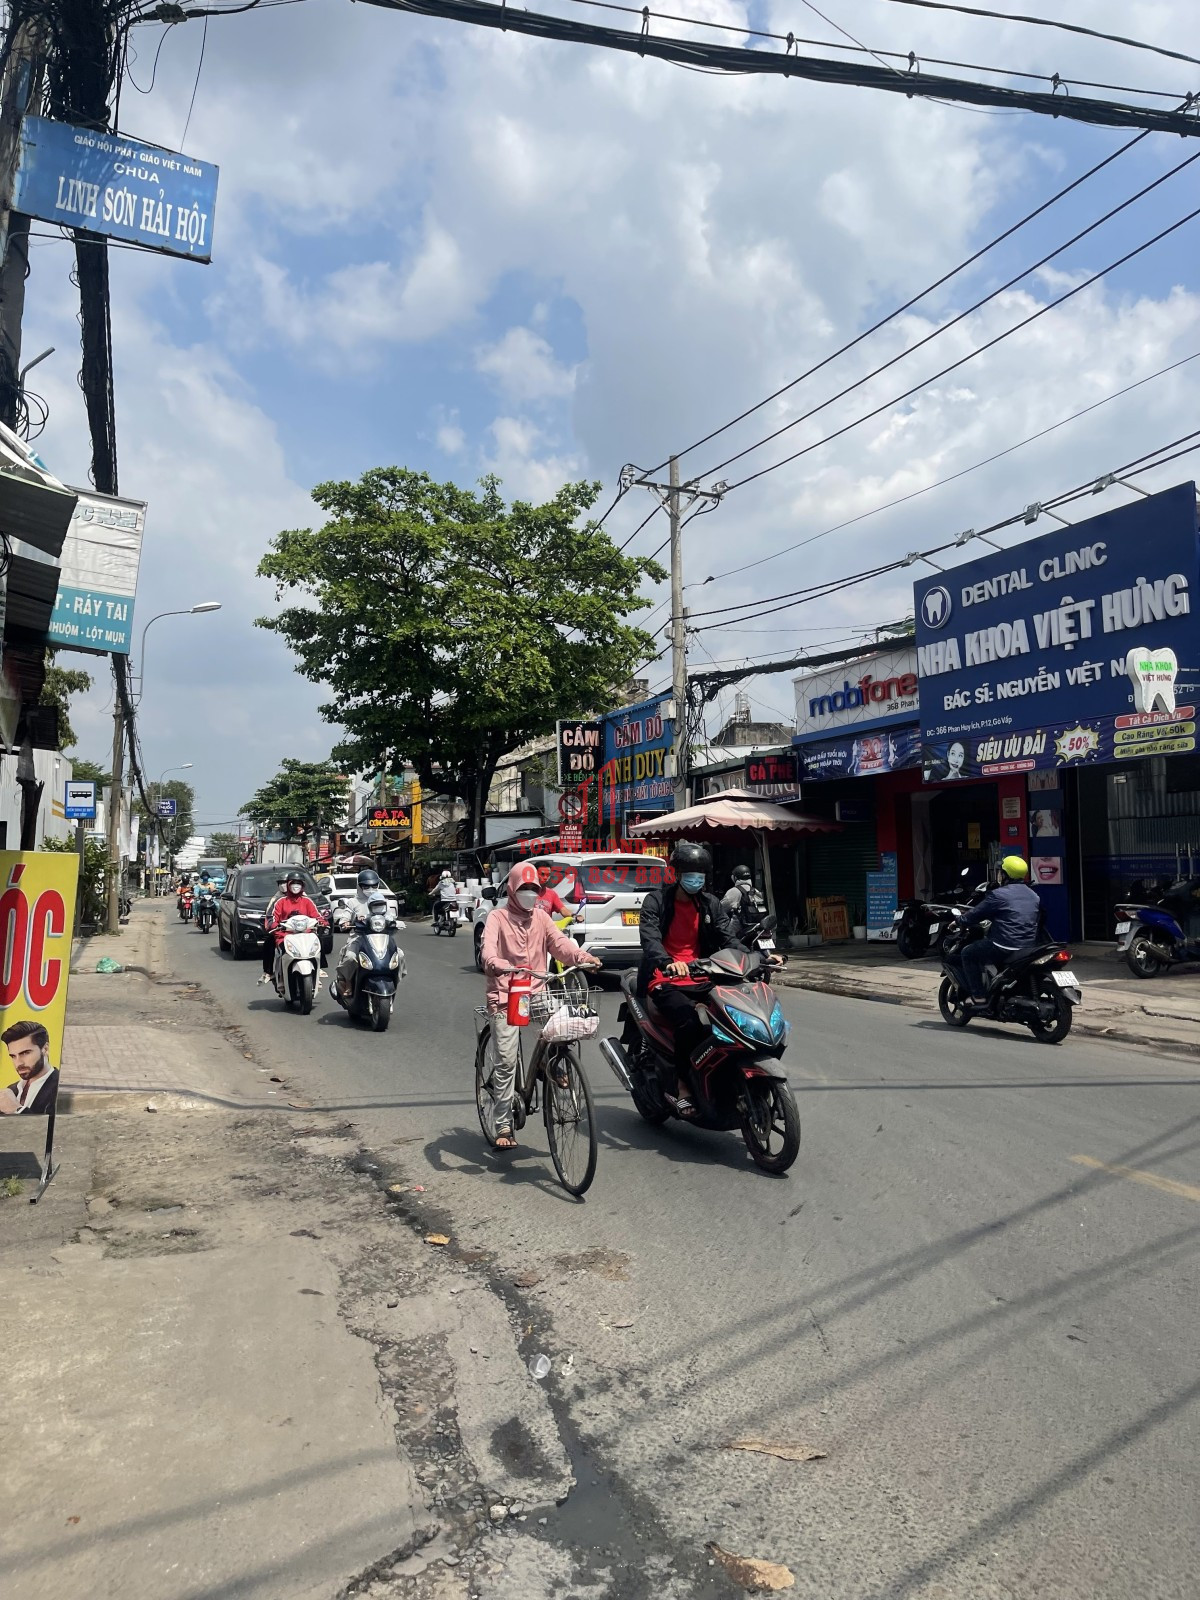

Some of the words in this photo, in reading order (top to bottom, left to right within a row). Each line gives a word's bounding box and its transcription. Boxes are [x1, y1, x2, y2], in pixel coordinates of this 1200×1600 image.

[74, 134, 95, 147] GIÁO
[97, 140, 112, 153] HỘI
[140, 152, 160, 165] GIÁO
[162, 157, 181, 171] VIỆT
[183, 165, 202, 177] NAM
[113, 162, 160, 183] CHÙA
[55, 175, 100, 217] LINH
[102, 186, 137, 227] SƠN
[139, 188, 172, 237] HẢI
[174, 201, 207, 251] HỘI
[961, 568, 1034, 608] DENTAL
[1038, 541, 1108, 581] CLINIC
[73, 594, 103, 618] RÁY
[106, 601, 128, 621] TAI
[86, 625, 104, 641] LỘT
[105, 629, 125, 645] MỤN
[917, 638, 962, 679] NHA
[964, 618, 1030, 666] KHOA
[1032, 595, 1096, 650] VIỆT
[1101, 573, 1190, 633] HƯNG
[943, 688, 972, 711] BÁC
[996, 665, 1061, 700] NGUYỄN
[1065, 660, 1105, 686] VIỆT
[1142, 672, 1155, 683] VIỆT
[1156, 673, 1172, 682] HƯNG
[808, 673, 918, 718] mobifone
[562, 724, 600, 747] CẦM
[613, 714, 643, 749] CẦM
[976, 736, 1003, 762] SIÊU
[1003, 734, 1023, 758] ƯU
[570, 747, 595, 770] ĐỒ
[604, 756, 632, 786] ANH
[634, 748, 666, 780] DUY
